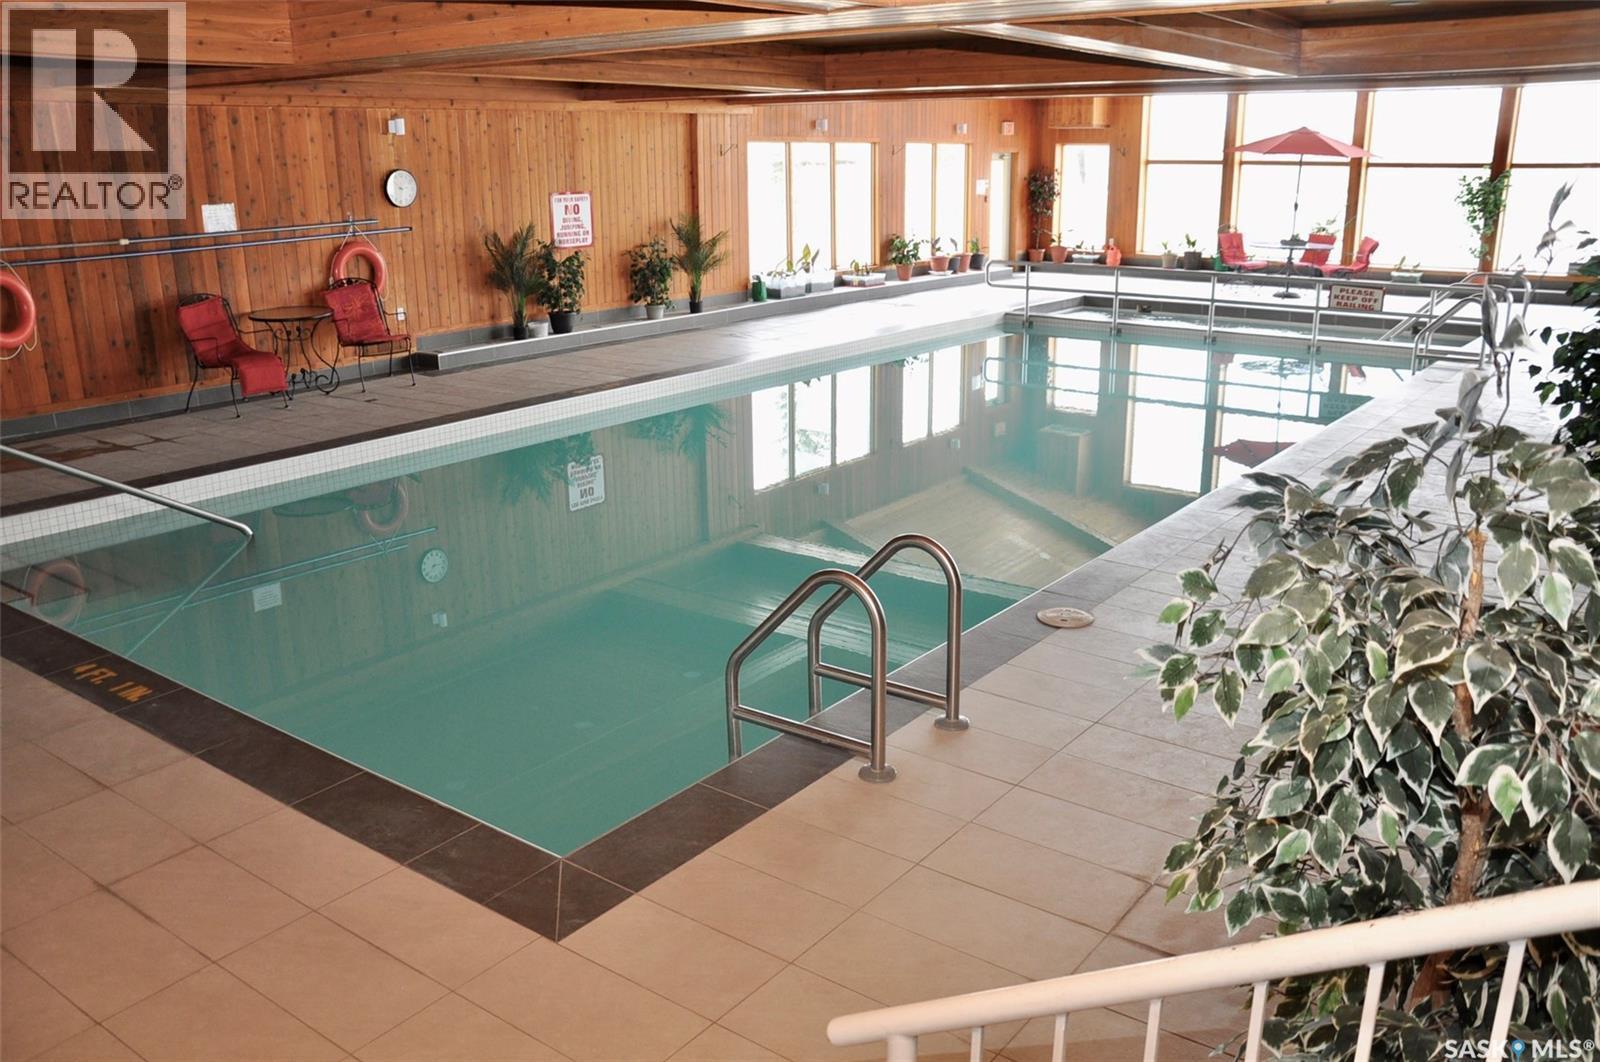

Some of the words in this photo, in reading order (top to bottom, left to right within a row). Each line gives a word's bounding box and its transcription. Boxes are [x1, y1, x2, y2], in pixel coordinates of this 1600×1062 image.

[564, 203, 580, 215] NO
[1339, 288, 1375, 296] PLEASE
[1336, 301, 1374, 310] RAILING
